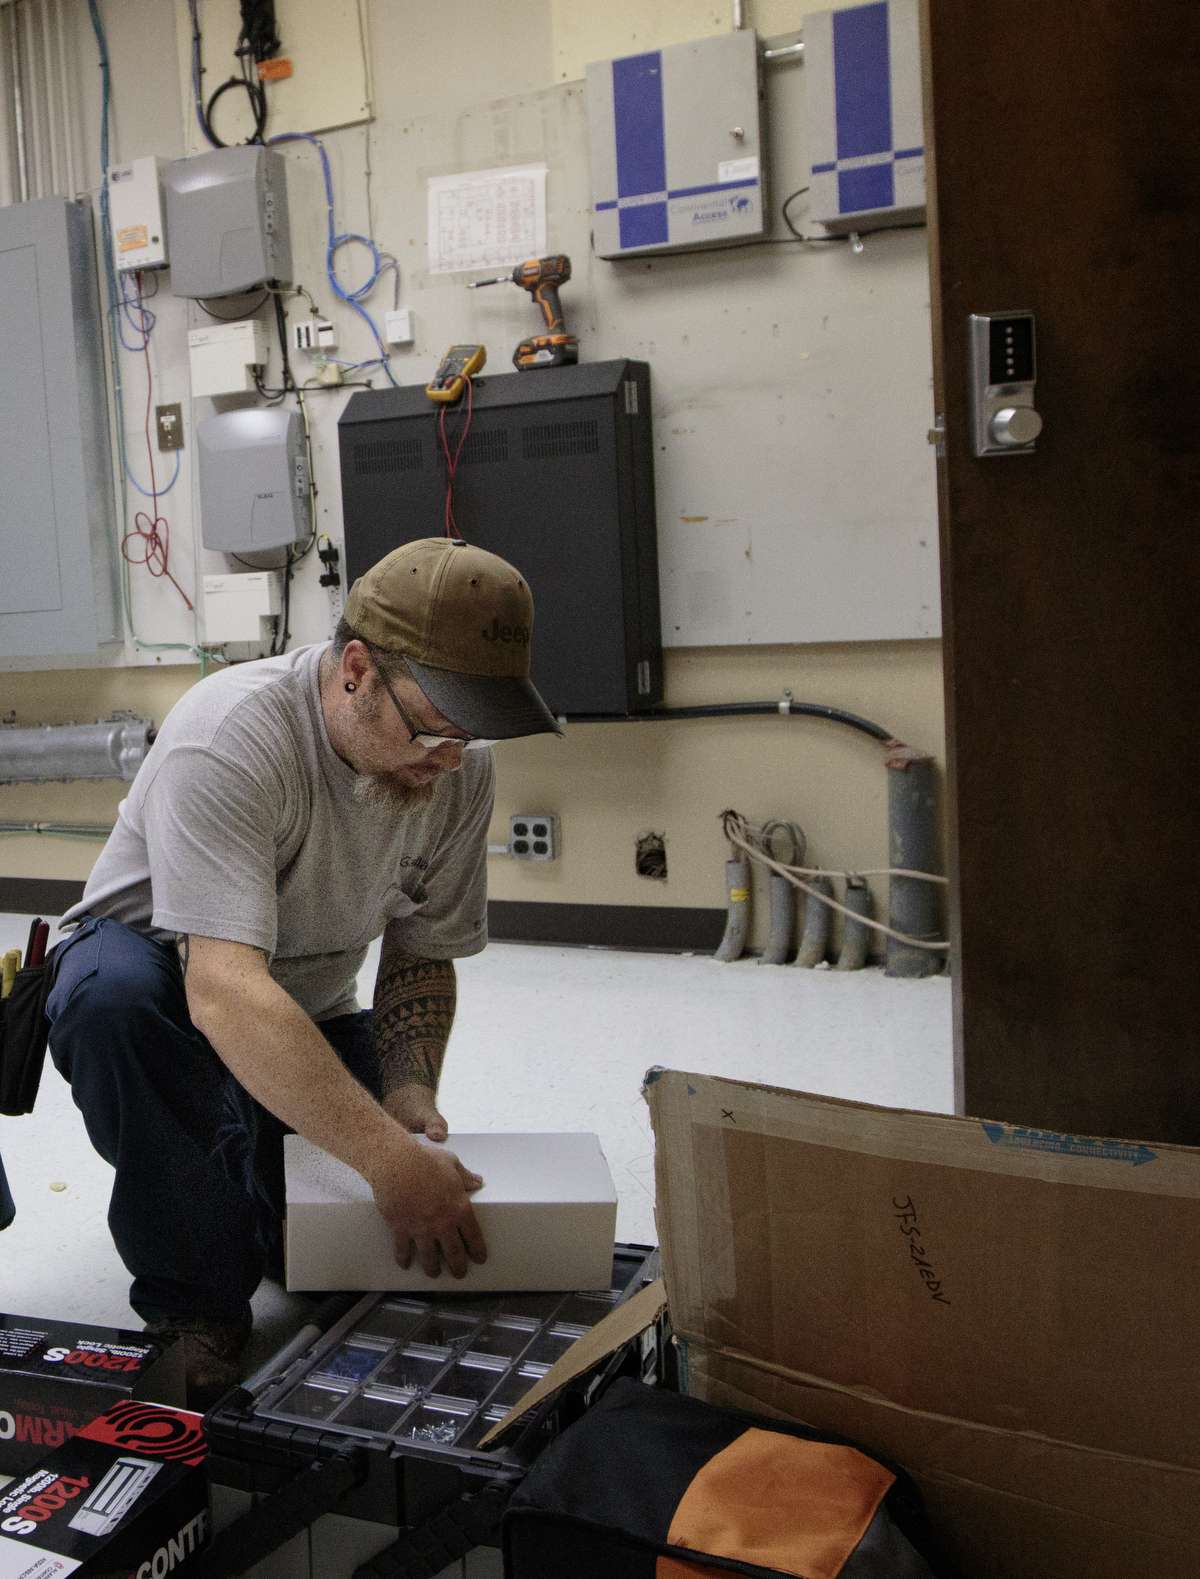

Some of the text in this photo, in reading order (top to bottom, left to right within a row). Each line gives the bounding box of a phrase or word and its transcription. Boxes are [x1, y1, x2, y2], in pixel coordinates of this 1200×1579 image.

[76, 1340, 150, 1354] Magnetic Lock
[76, 1345, 108, 1354] Single
[43, 1347, 141, 1372] 1200S
[9, 1469, 50, 1497] Magnetic
[1, 1475, 90, 1535] 1200S
[2, 1493, 32, 1514] Single
